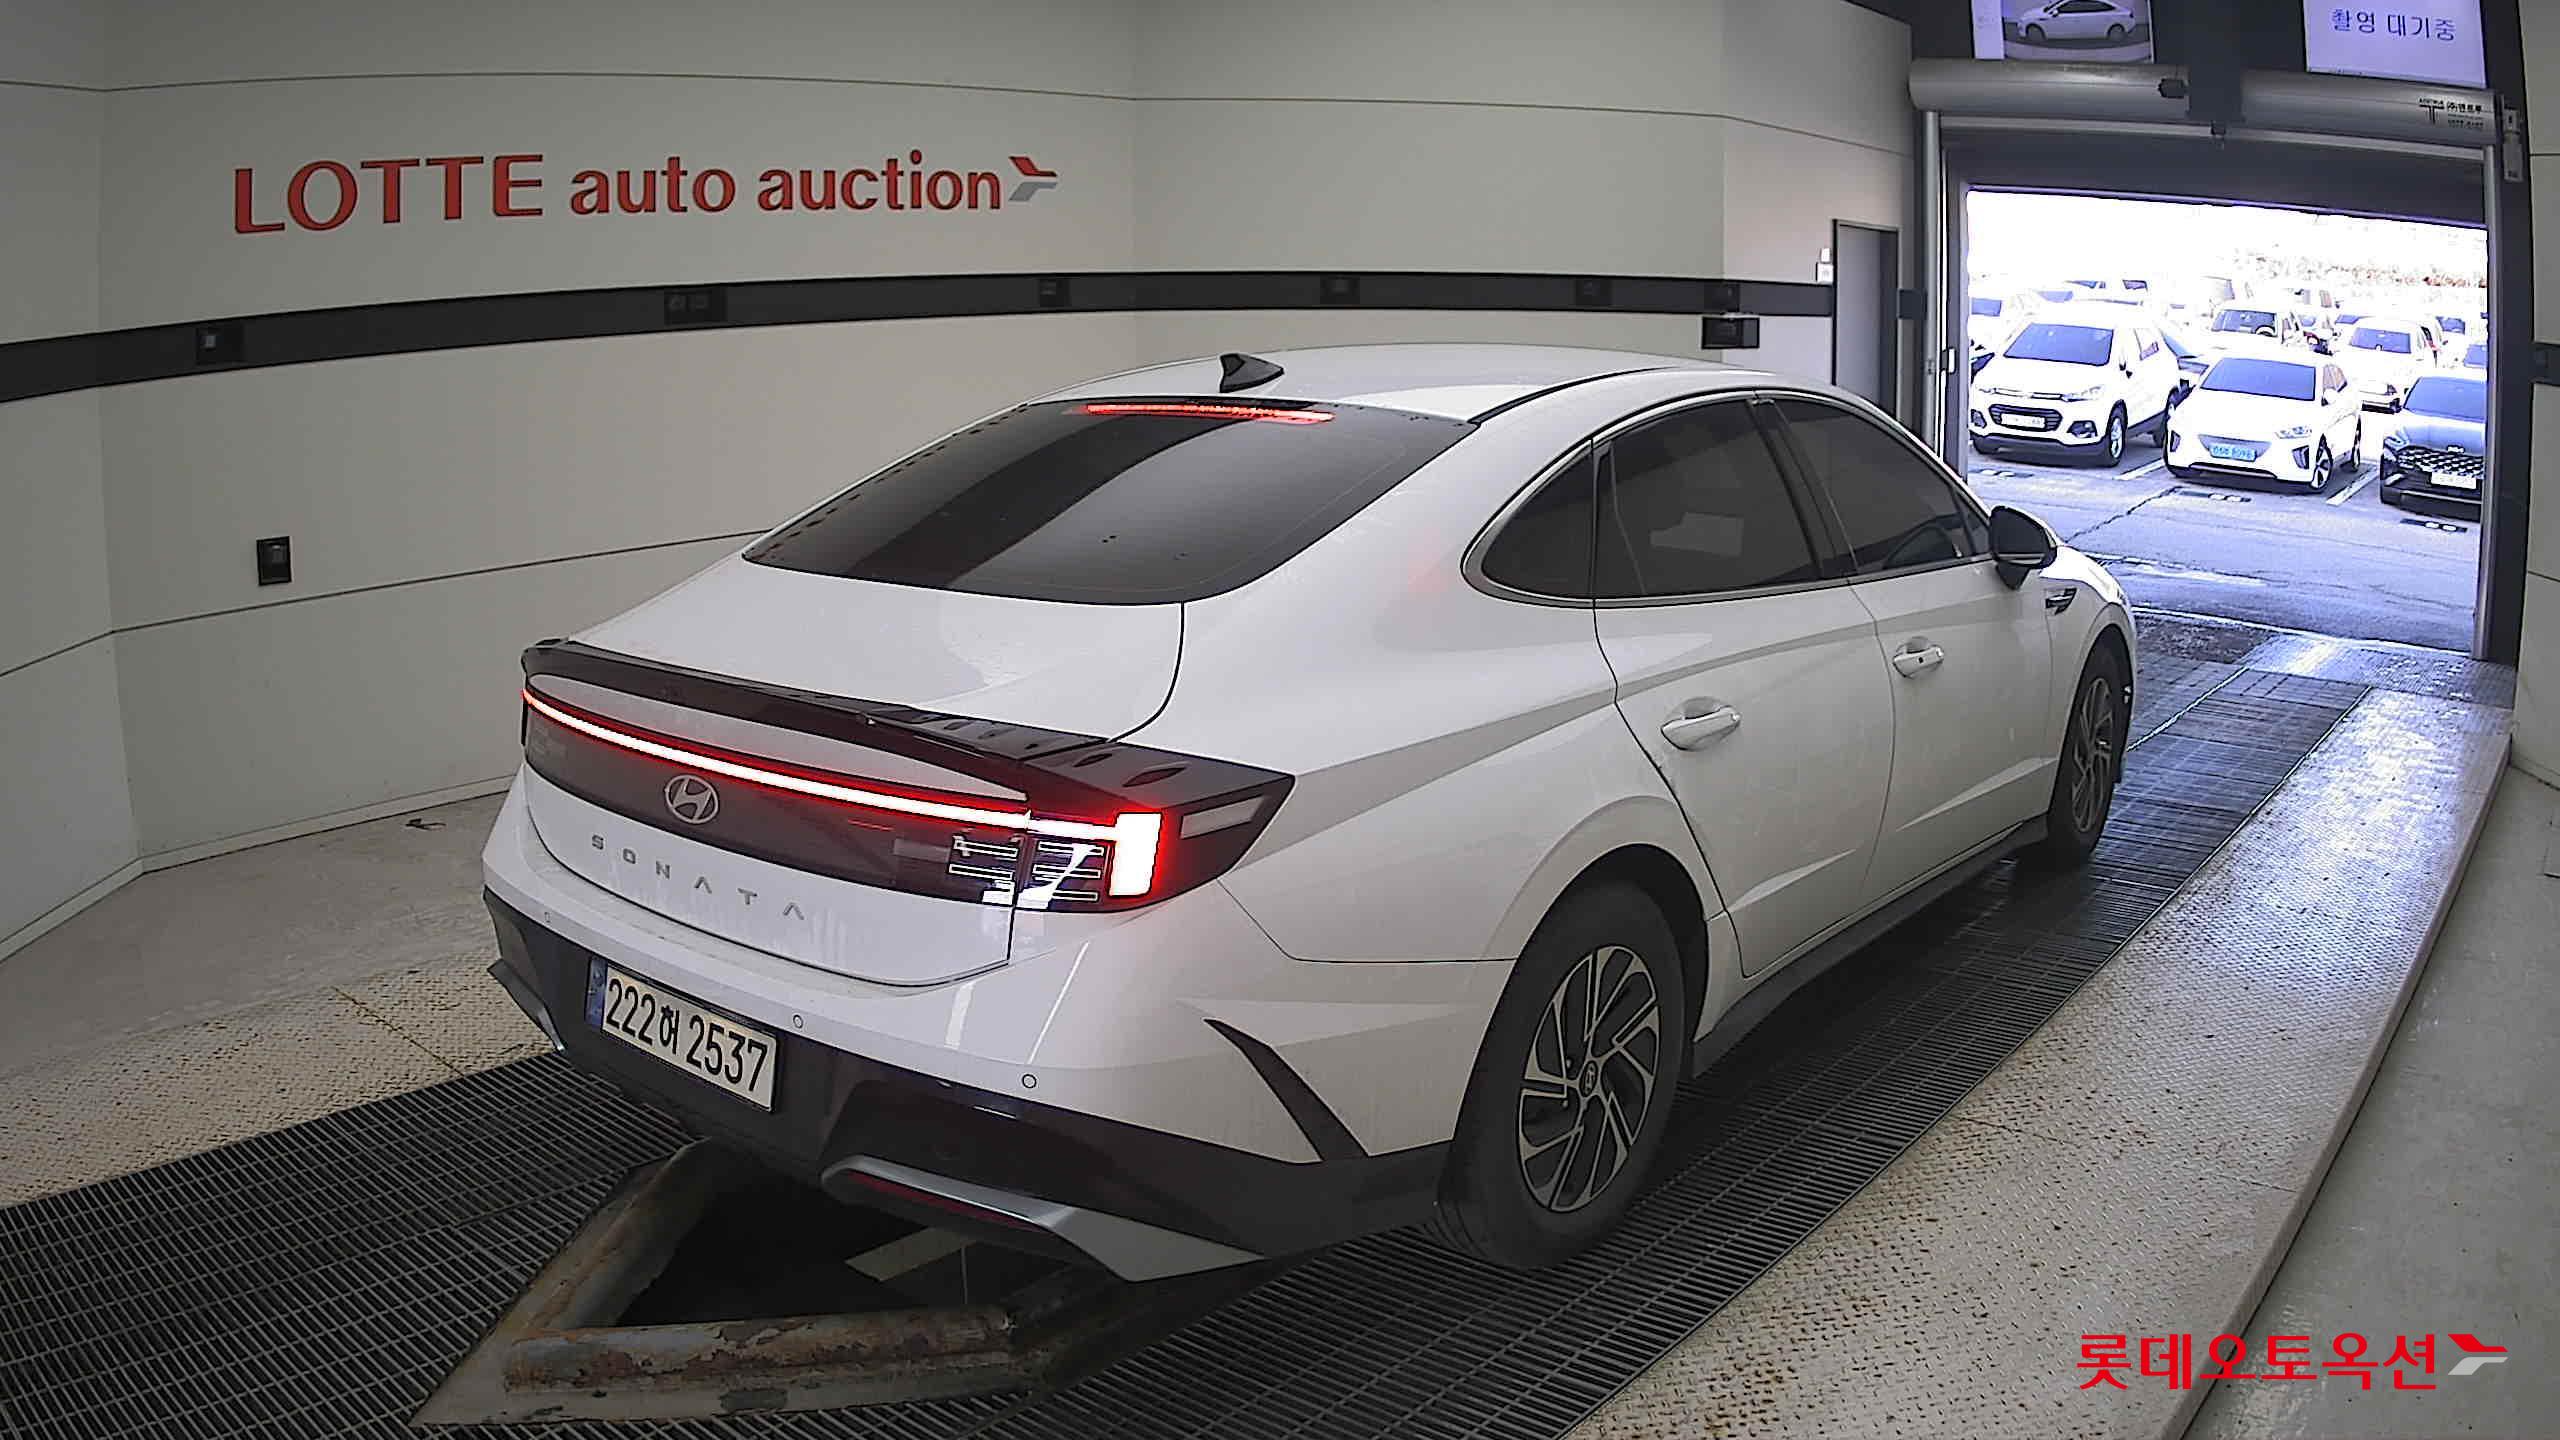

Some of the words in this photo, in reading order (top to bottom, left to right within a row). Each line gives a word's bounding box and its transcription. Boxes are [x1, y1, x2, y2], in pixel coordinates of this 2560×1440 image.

[2332, 8, 2376, 34] 촬영
[2387, 14, 2456, 42] 대기중
[234, 153, 544, 234] LOTTE
[570, 156, 737, 215] auto
[757, 149, 1002, 211] auction
[591, 834, 805, 921] SONATA
[605, 977, 681, 1056] 222허
[686, 1014, 769, 1092] 2537
